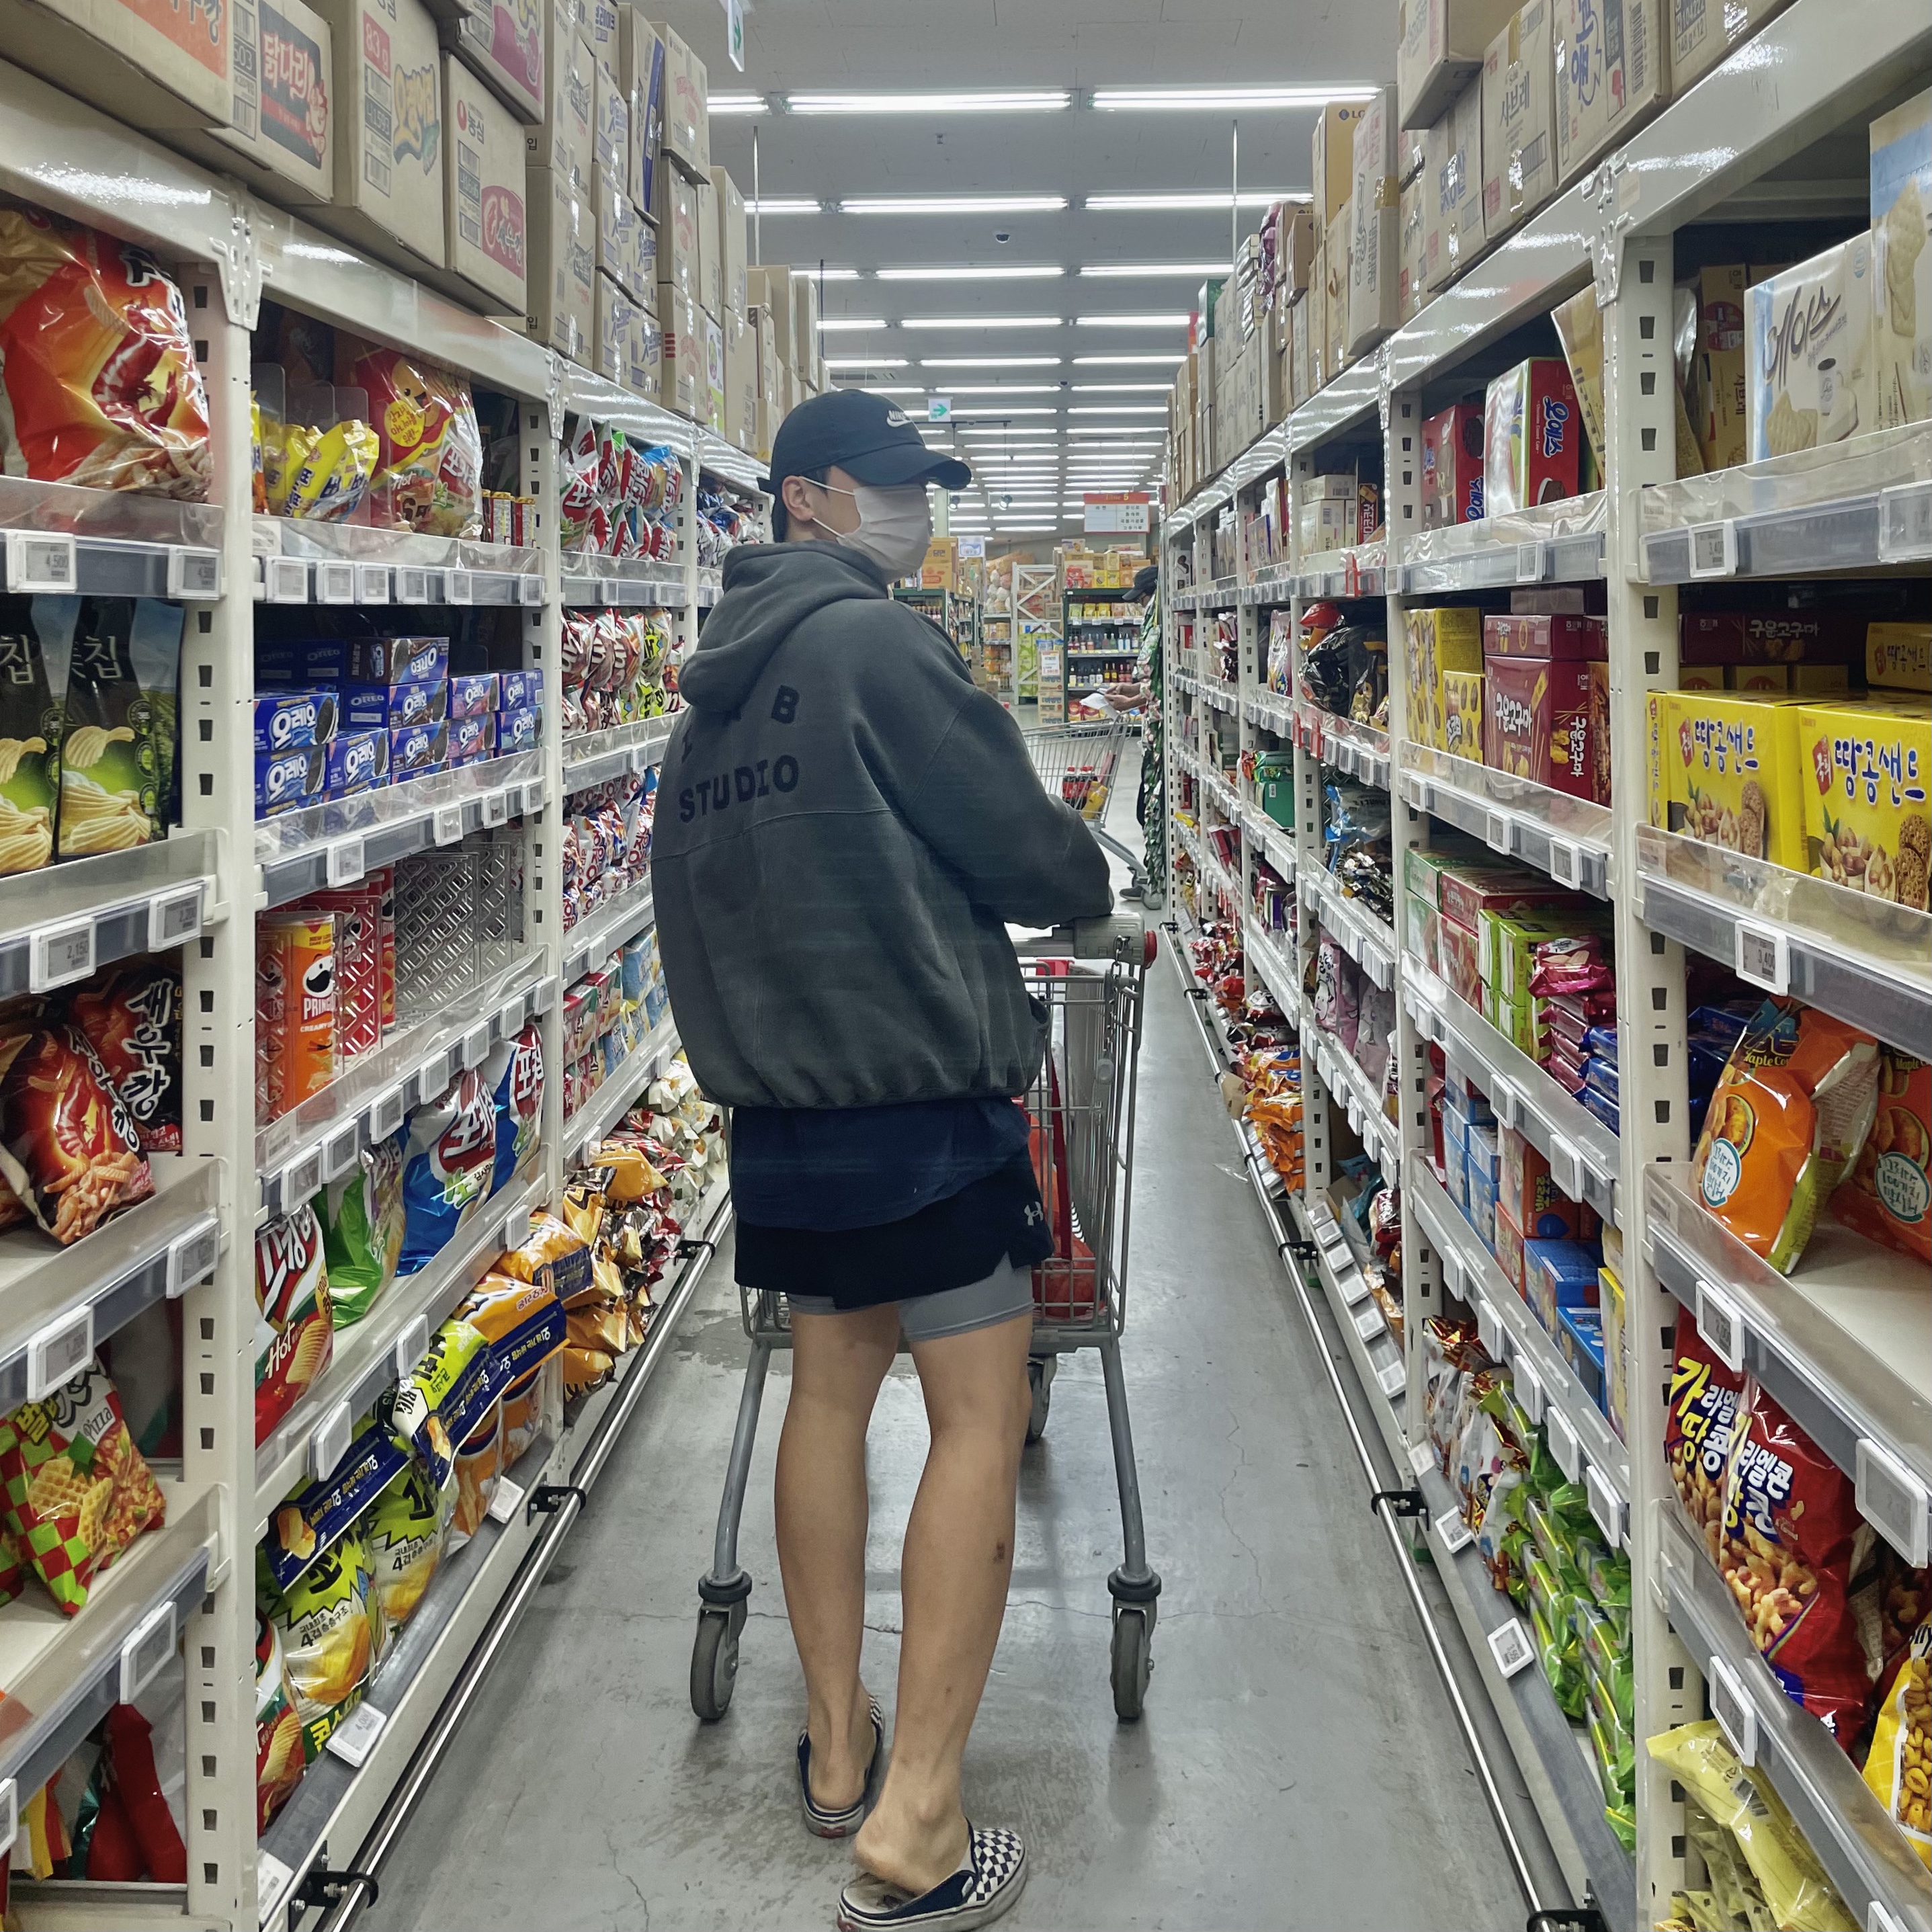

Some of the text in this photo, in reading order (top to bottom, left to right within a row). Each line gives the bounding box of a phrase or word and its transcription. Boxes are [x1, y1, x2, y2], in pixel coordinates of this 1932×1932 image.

[366, 23, 380, 58] 83
[1500, 71, 1531, 128] 사브레
[1749, 619, 1820, 638] 구운고구마
[307, 648, 340, 662] OREO
[351, 695, 384, 706] OREO
[404, 693, 427, 723] 오레오
[465, 683, 485, 710] 오레오
[771, 685, 800, 724] B
[1495, 692, 1532, 737] 구운고구마
[271, 704, 317, 749] 오레오
[460, 721, 479, 751] 오레오
[513, 714, 536, 745] 오레오
[345, 741, 376, 784] 오레오
[405, 734, 429, 764] 오레오
[1569, 715, 1587, 778] 구운고구마
[269, 755, 308, 802] 오레오
[679, 755, 798, 823] STUDIO
[119, 978, 173, 1120] 새우깡
[264, 1321, 296, 1379] Hot
[1669, 1357, 1742, 1425] 카라멜
[83, 1406, 114, 1443] Pizza
[1681, 1412, 1733, 1472] 땅콩
[392, 1554, 411, 1571] 4겹
[301, 1629, 322, 1648] 4겹
